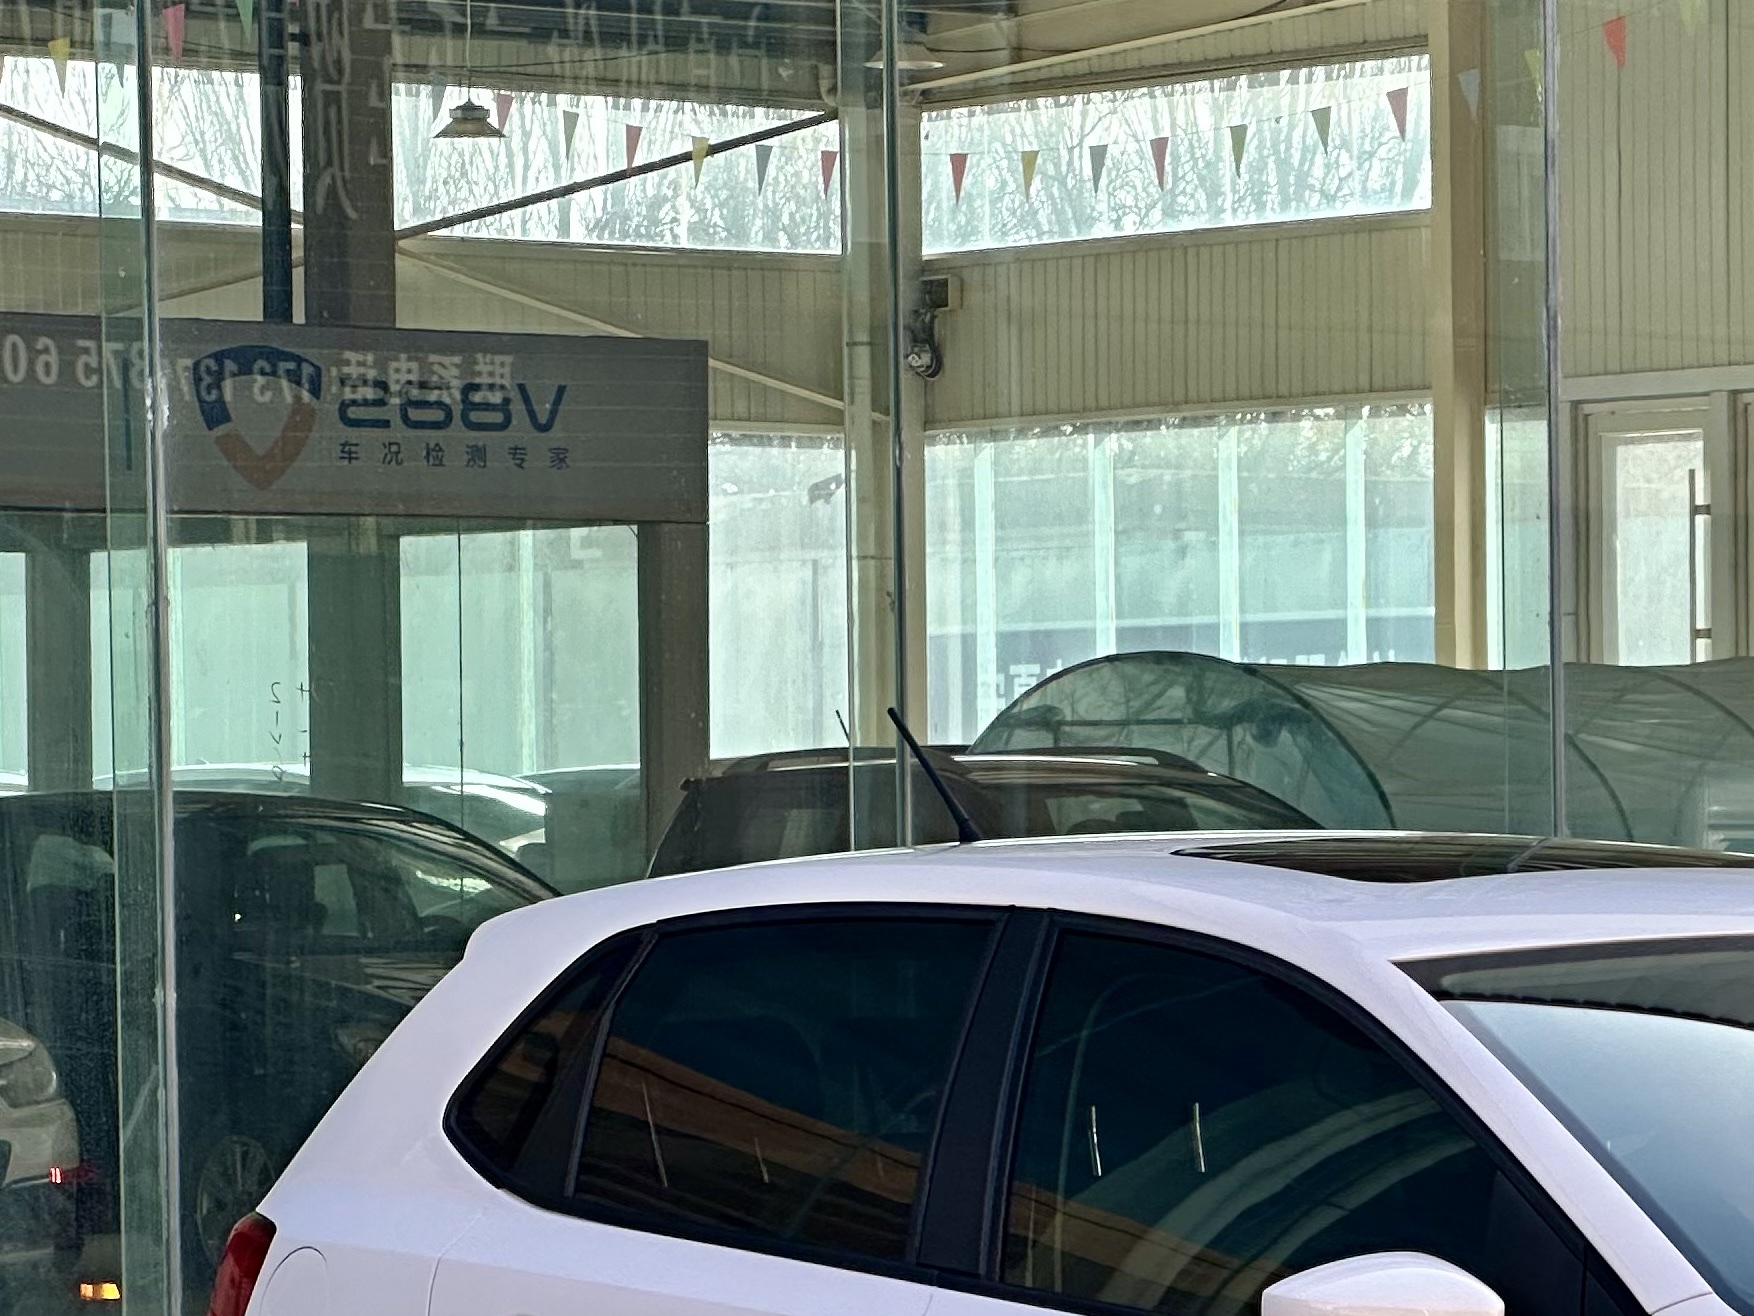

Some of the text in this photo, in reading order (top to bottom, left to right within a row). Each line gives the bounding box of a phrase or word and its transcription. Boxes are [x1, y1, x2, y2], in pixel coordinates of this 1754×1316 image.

[339, 440, 571, 470] 车况检测专家
